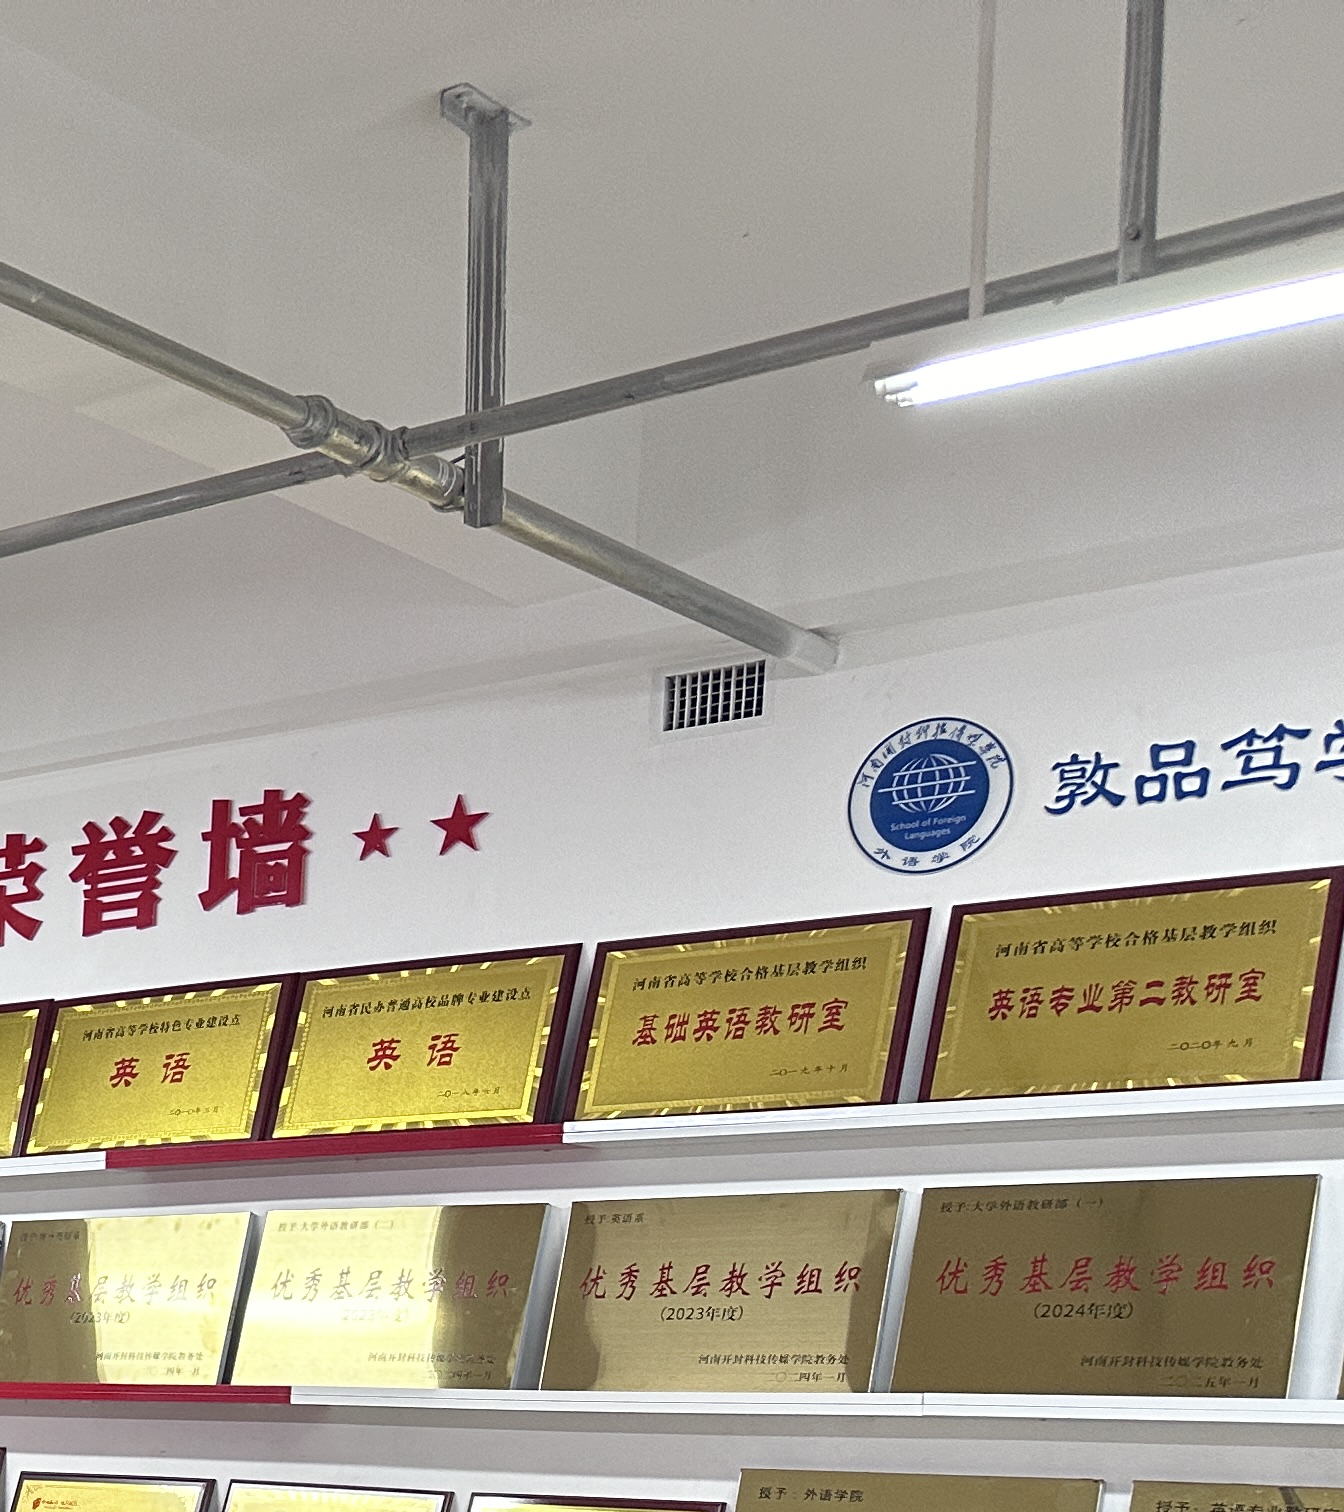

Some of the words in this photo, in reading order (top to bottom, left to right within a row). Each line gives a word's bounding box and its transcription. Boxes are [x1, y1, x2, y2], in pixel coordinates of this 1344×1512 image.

[890, 819, 920, 831] School
[921, 817, 932, 828] of
[933, 814, 967, 826] Foreign
[904, 828, 951, 841] Languages
[995, 918, 1279, 960] 河南省高等学校合格基层教学组织
[632, 955, 869, 993] 河南省高等学校合格基层教学组织
[988, 968, 1268, 1022] 英语专业第二教研室
[631, 997, 851, 1048] 基础英语教研室
[109, 1052, 191, 1088] 英语
[366, 1033, 462, 1072] 英语
[270, 1265, 510, 1303] 优秀基层教学组织
[579, 1261, 863, 1300] 优秀基层教学组织
[935, 1253, 1277, 1297] 优秀基层教学组织
